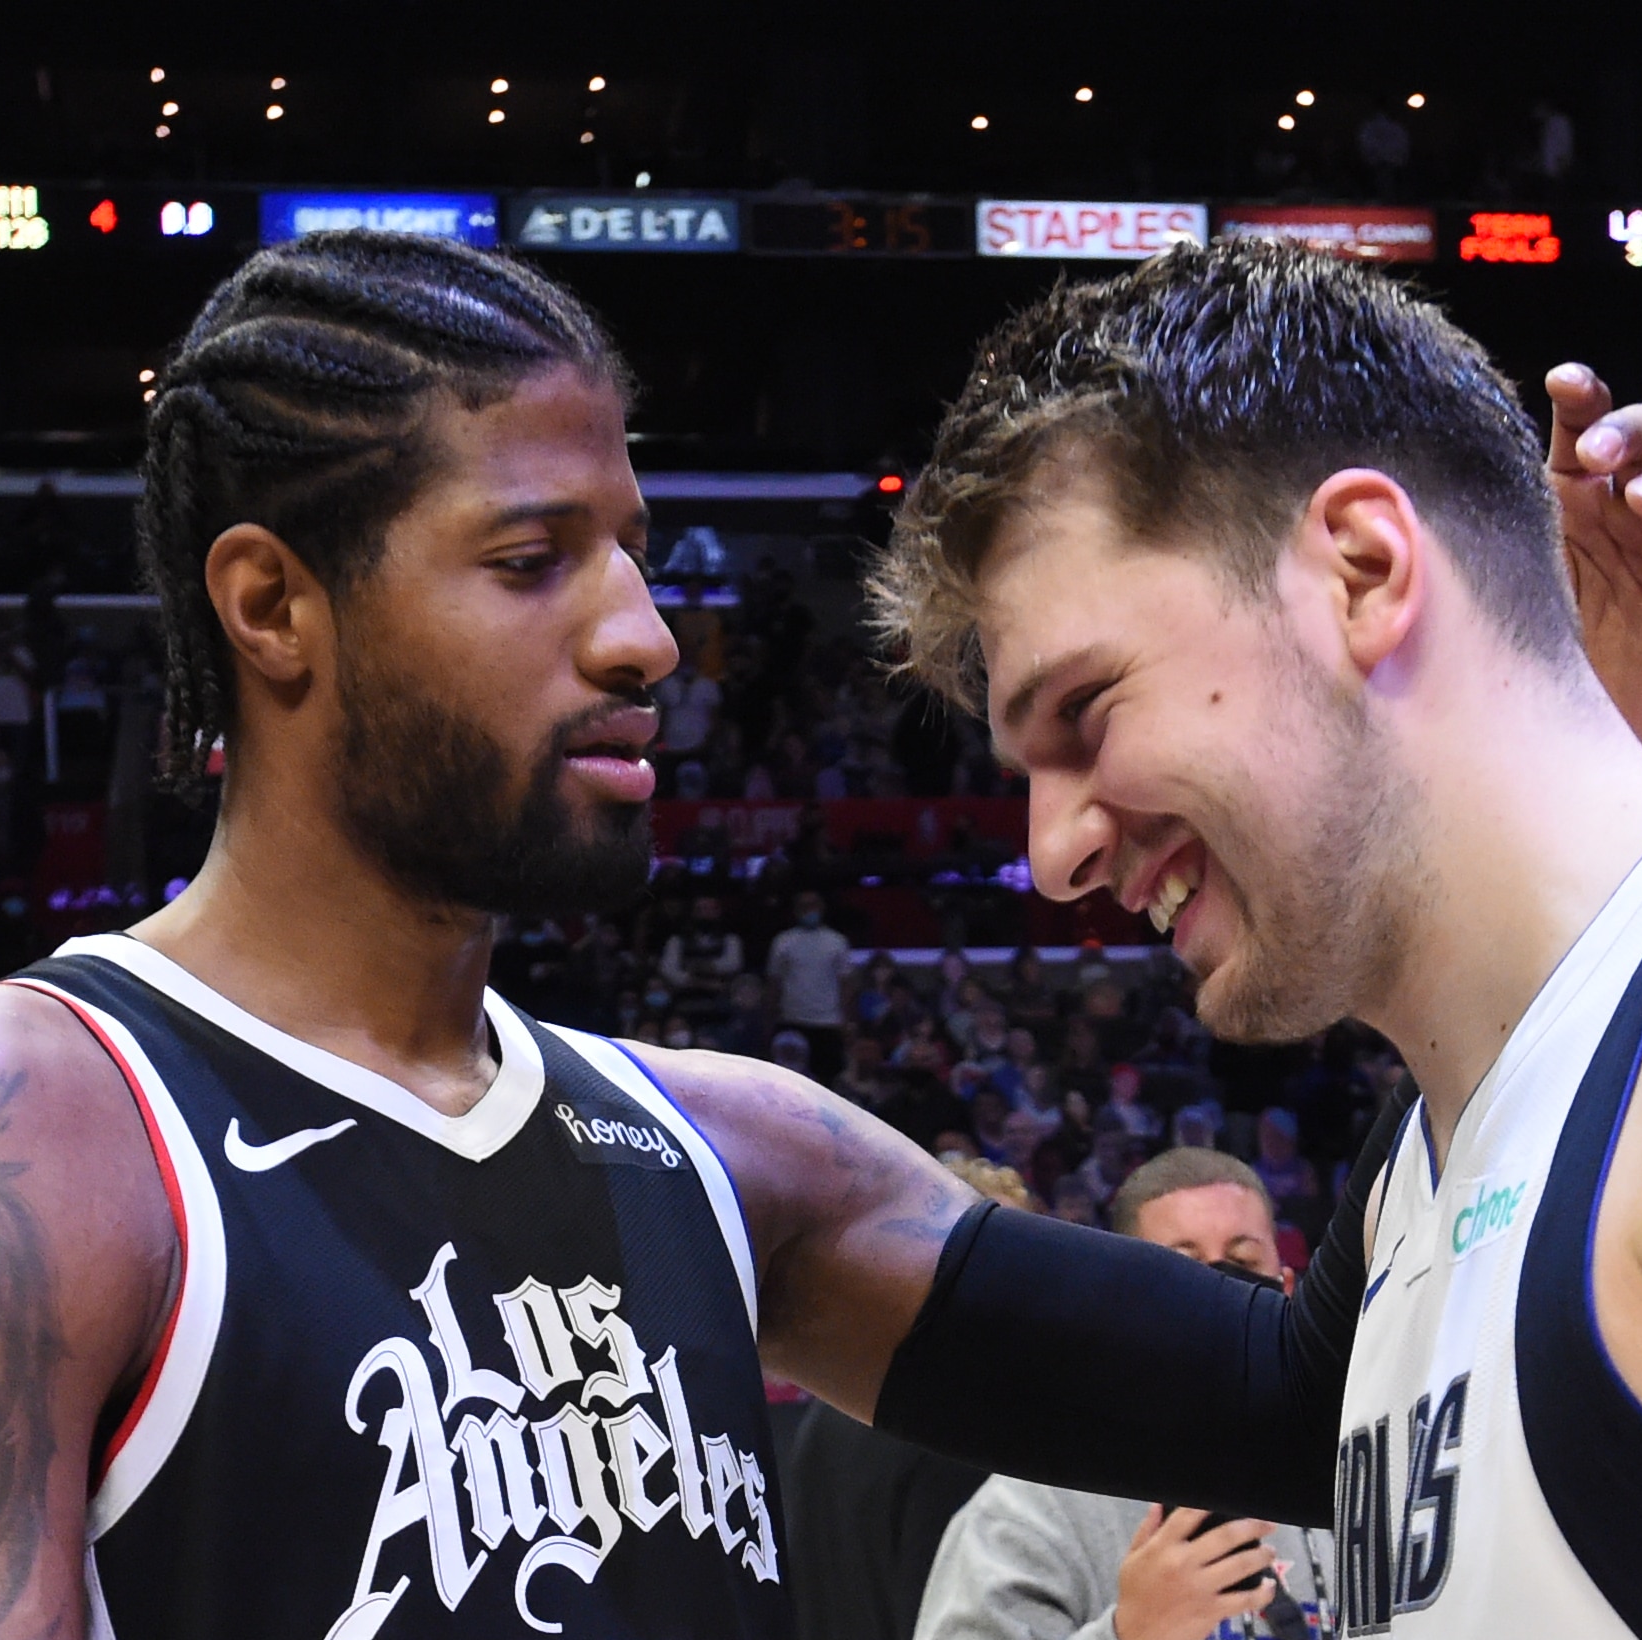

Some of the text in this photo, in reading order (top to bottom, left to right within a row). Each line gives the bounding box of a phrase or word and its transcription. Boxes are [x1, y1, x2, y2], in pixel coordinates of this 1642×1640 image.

[569, 207, 730, 243] DELTA
[984, 207, 1195, 252] STAPLES
[555, 1103, 683, 1168] honey
[409, 1241, 653, 1422] Los
